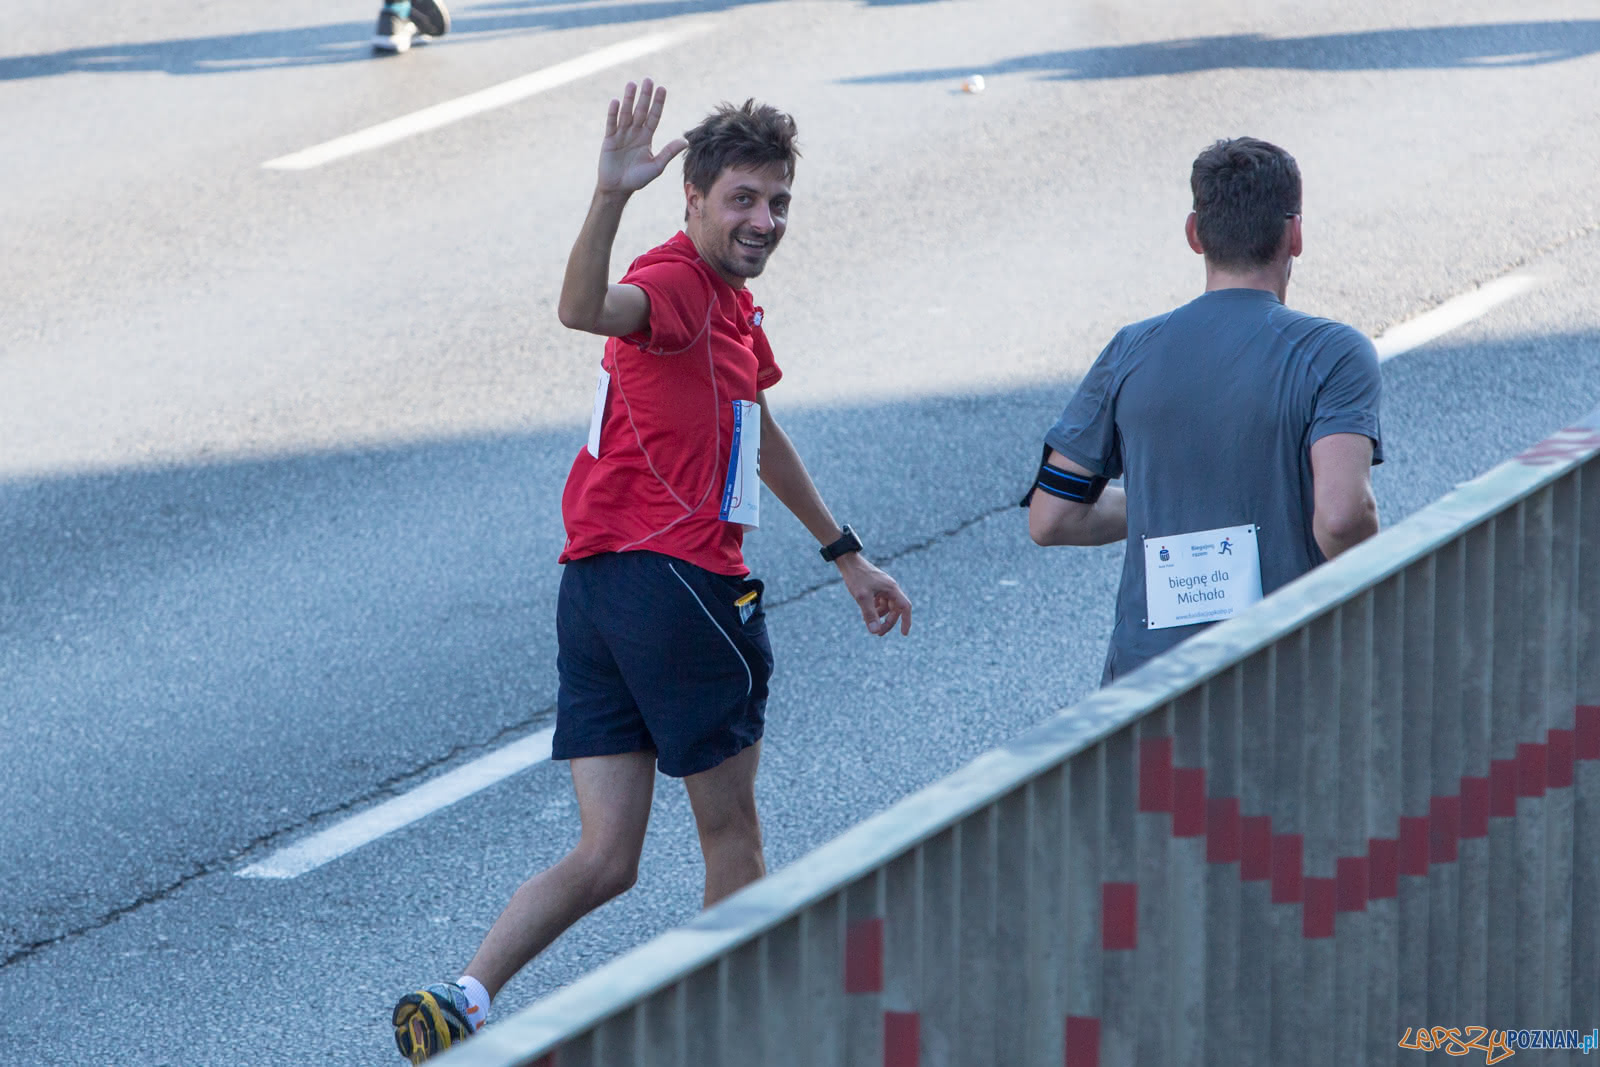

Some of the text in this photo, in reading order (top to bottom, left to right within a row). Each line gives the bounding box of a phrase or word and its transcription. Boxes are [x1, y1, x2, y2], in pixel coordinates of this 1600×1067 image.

[1169, 570, 1229, 590] biegnę dla
[1178, 588, 1225, 605] Michała
